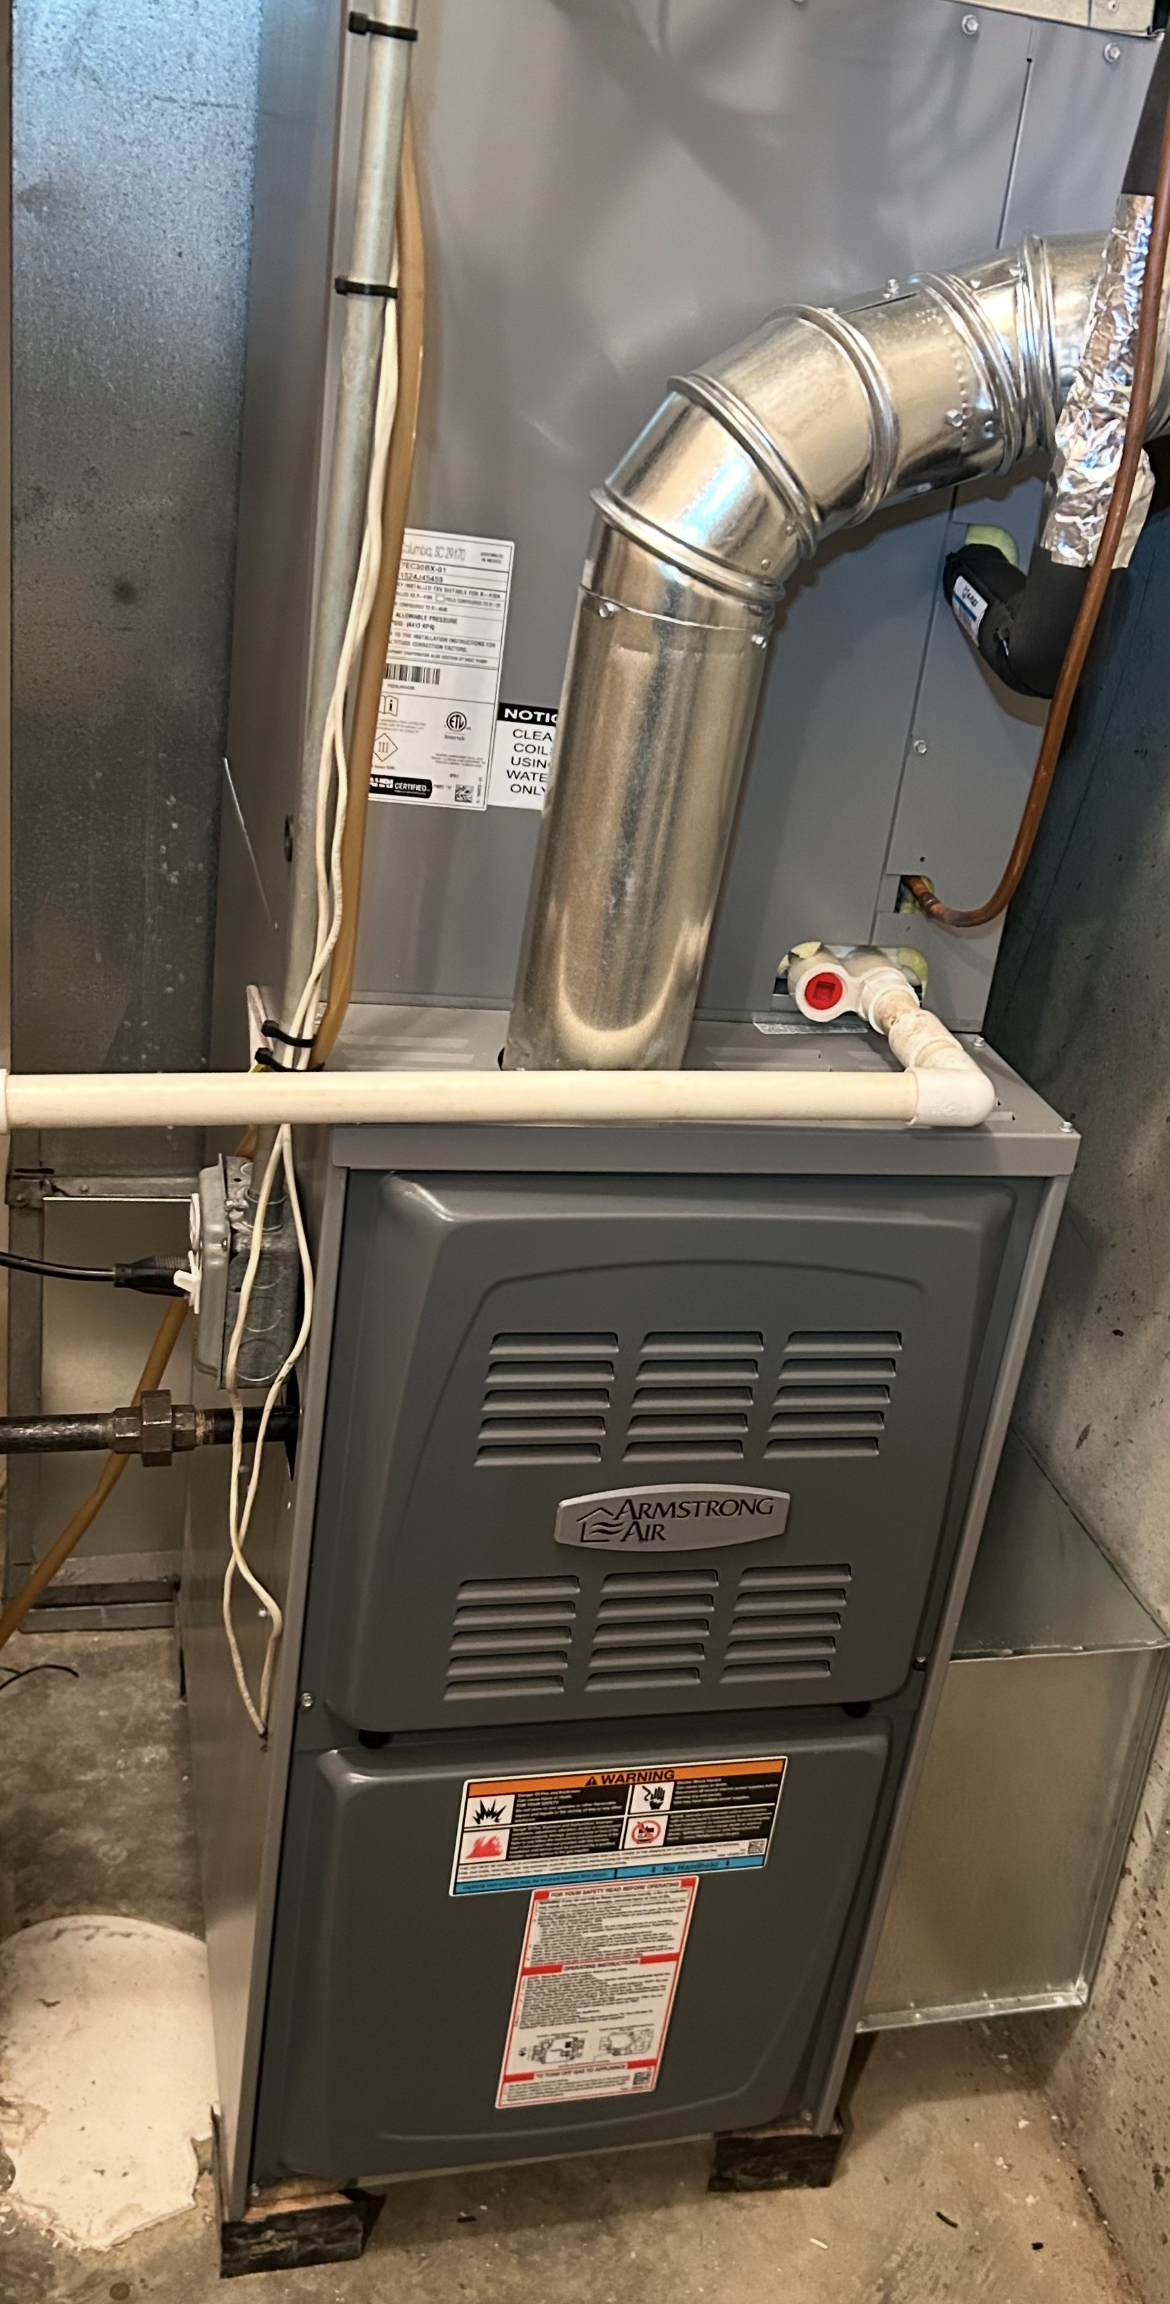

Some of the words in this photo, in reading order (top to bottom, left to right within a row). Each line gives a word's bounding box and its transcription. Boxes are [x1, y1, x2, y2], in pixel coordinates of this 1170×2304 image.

[512, 728, 553, 742] CLEA
[513, 742, 552, 755] COIL
[511, 756, 550, 769] USIN
[506, 769, 548, 783] WATE
[394, 782, 428, 792] CERTIFIED
[613, 1498, 773, 1520] ARMSTRONG
[620, 1521, 666, 1542] AIR
[601, 1770, 675, 1785] WARNING
